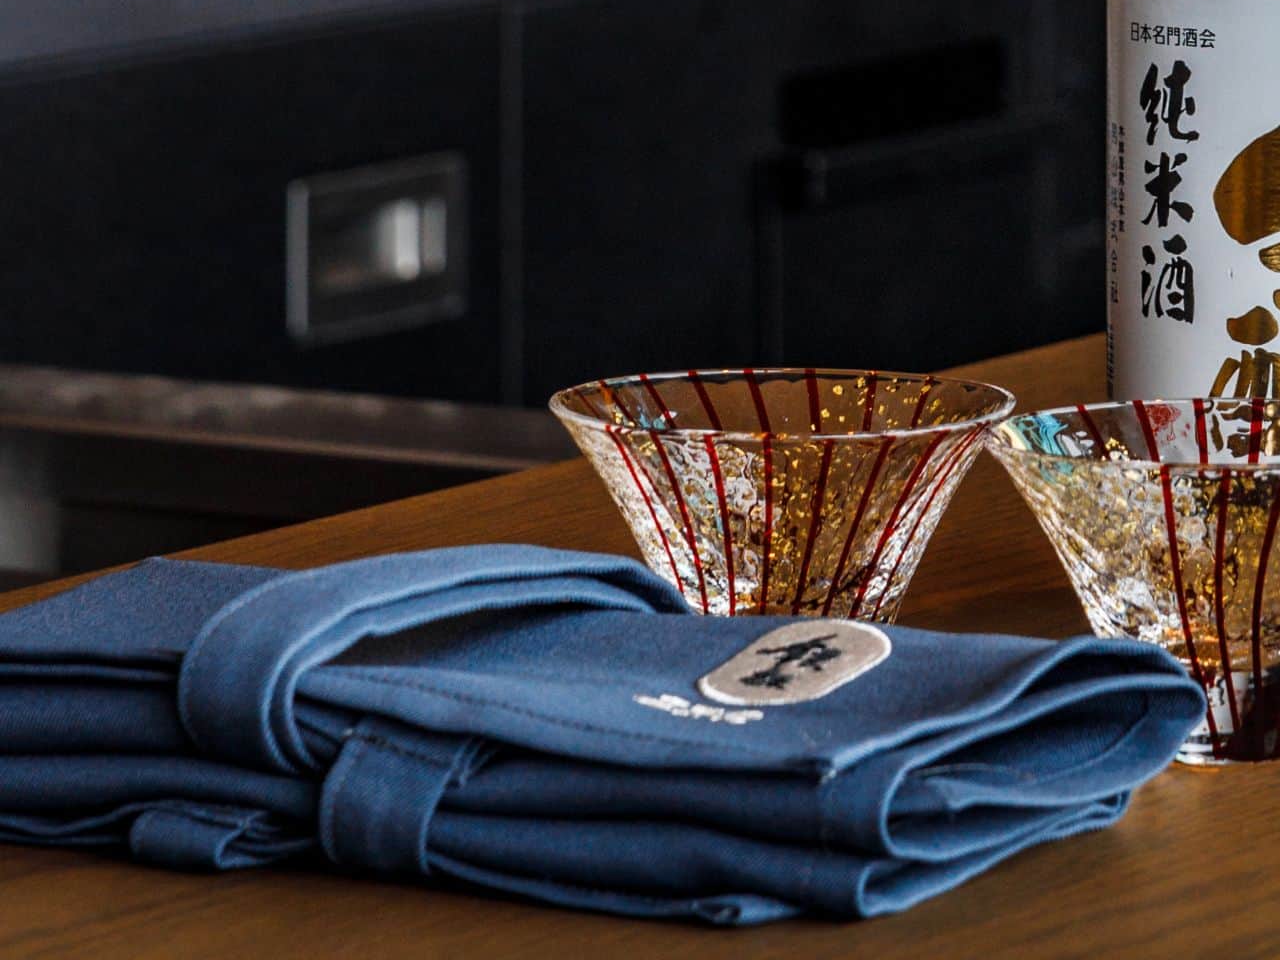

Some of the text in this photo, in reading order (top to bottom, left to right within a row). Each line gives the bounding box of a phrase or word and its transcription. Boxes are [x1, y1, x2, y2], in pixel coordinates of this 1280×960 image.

[1130, 21, 1216, 49] 日本名門酒会
[1140, 60, 1200, 324] 純米酒
